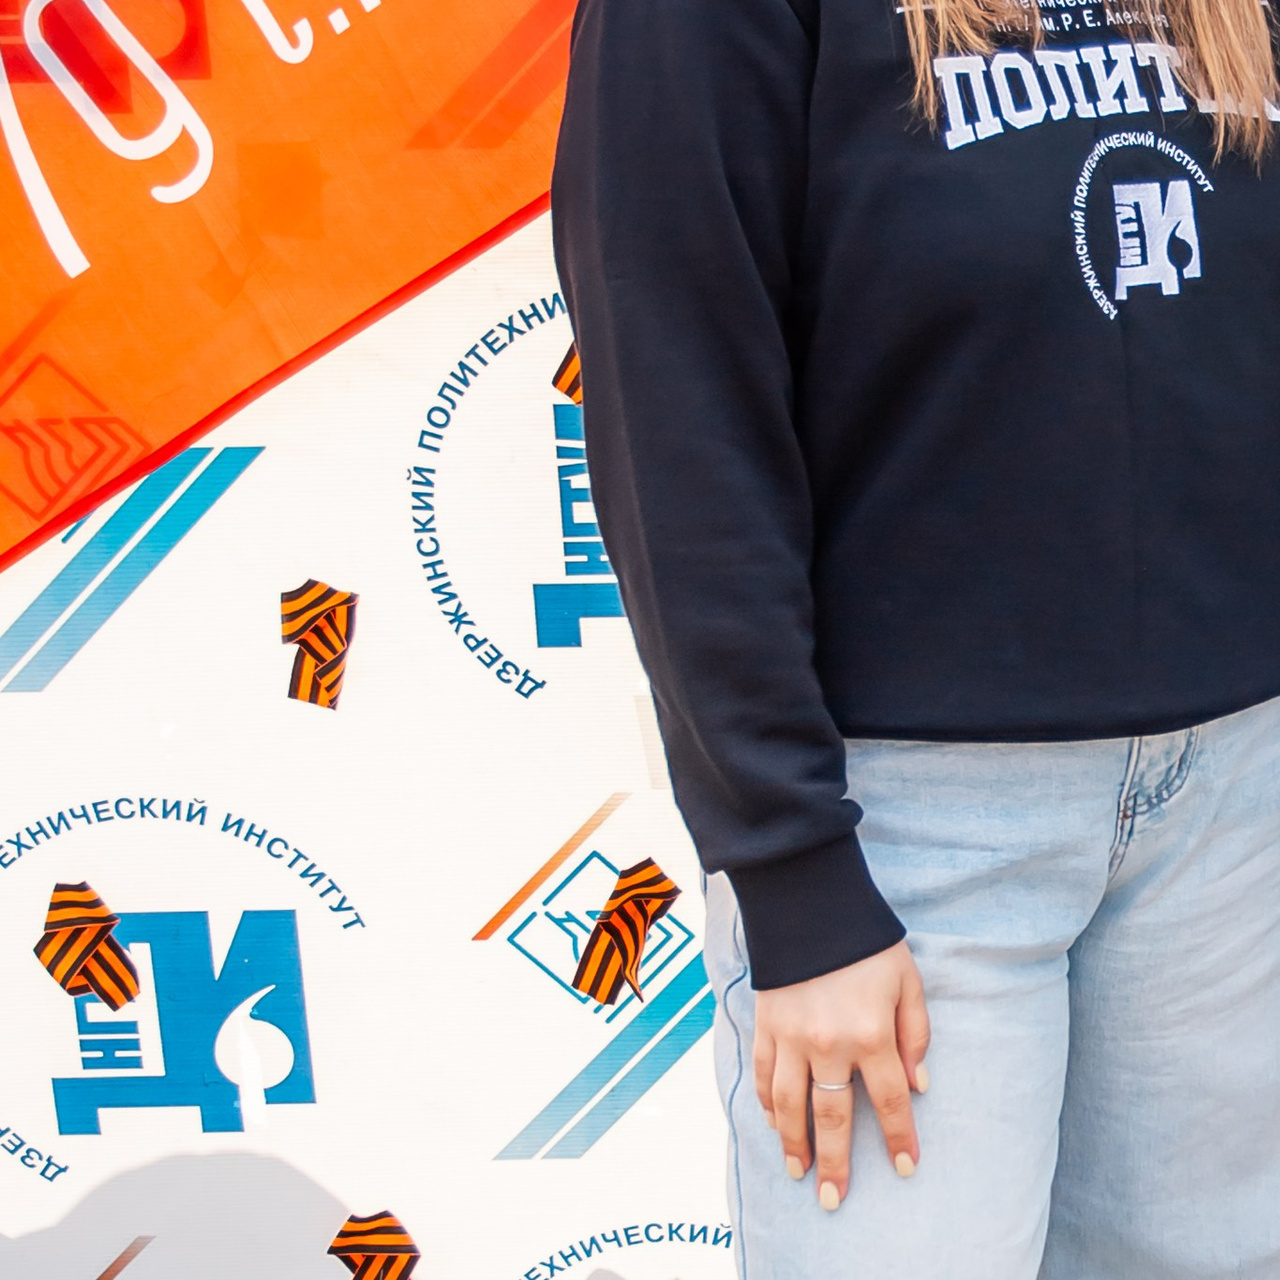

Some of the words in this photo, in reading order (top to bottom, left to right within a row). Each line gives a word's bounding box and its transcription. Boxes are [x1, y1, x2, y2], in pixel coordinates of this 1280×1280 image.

[1157, 137, 1214, 193] ИНСТИТУТ
[406, 465, 546, 700] ДЗЕРЖИНСКИЙ
[221, 812, 367, 931] ИНСТИТУТ
